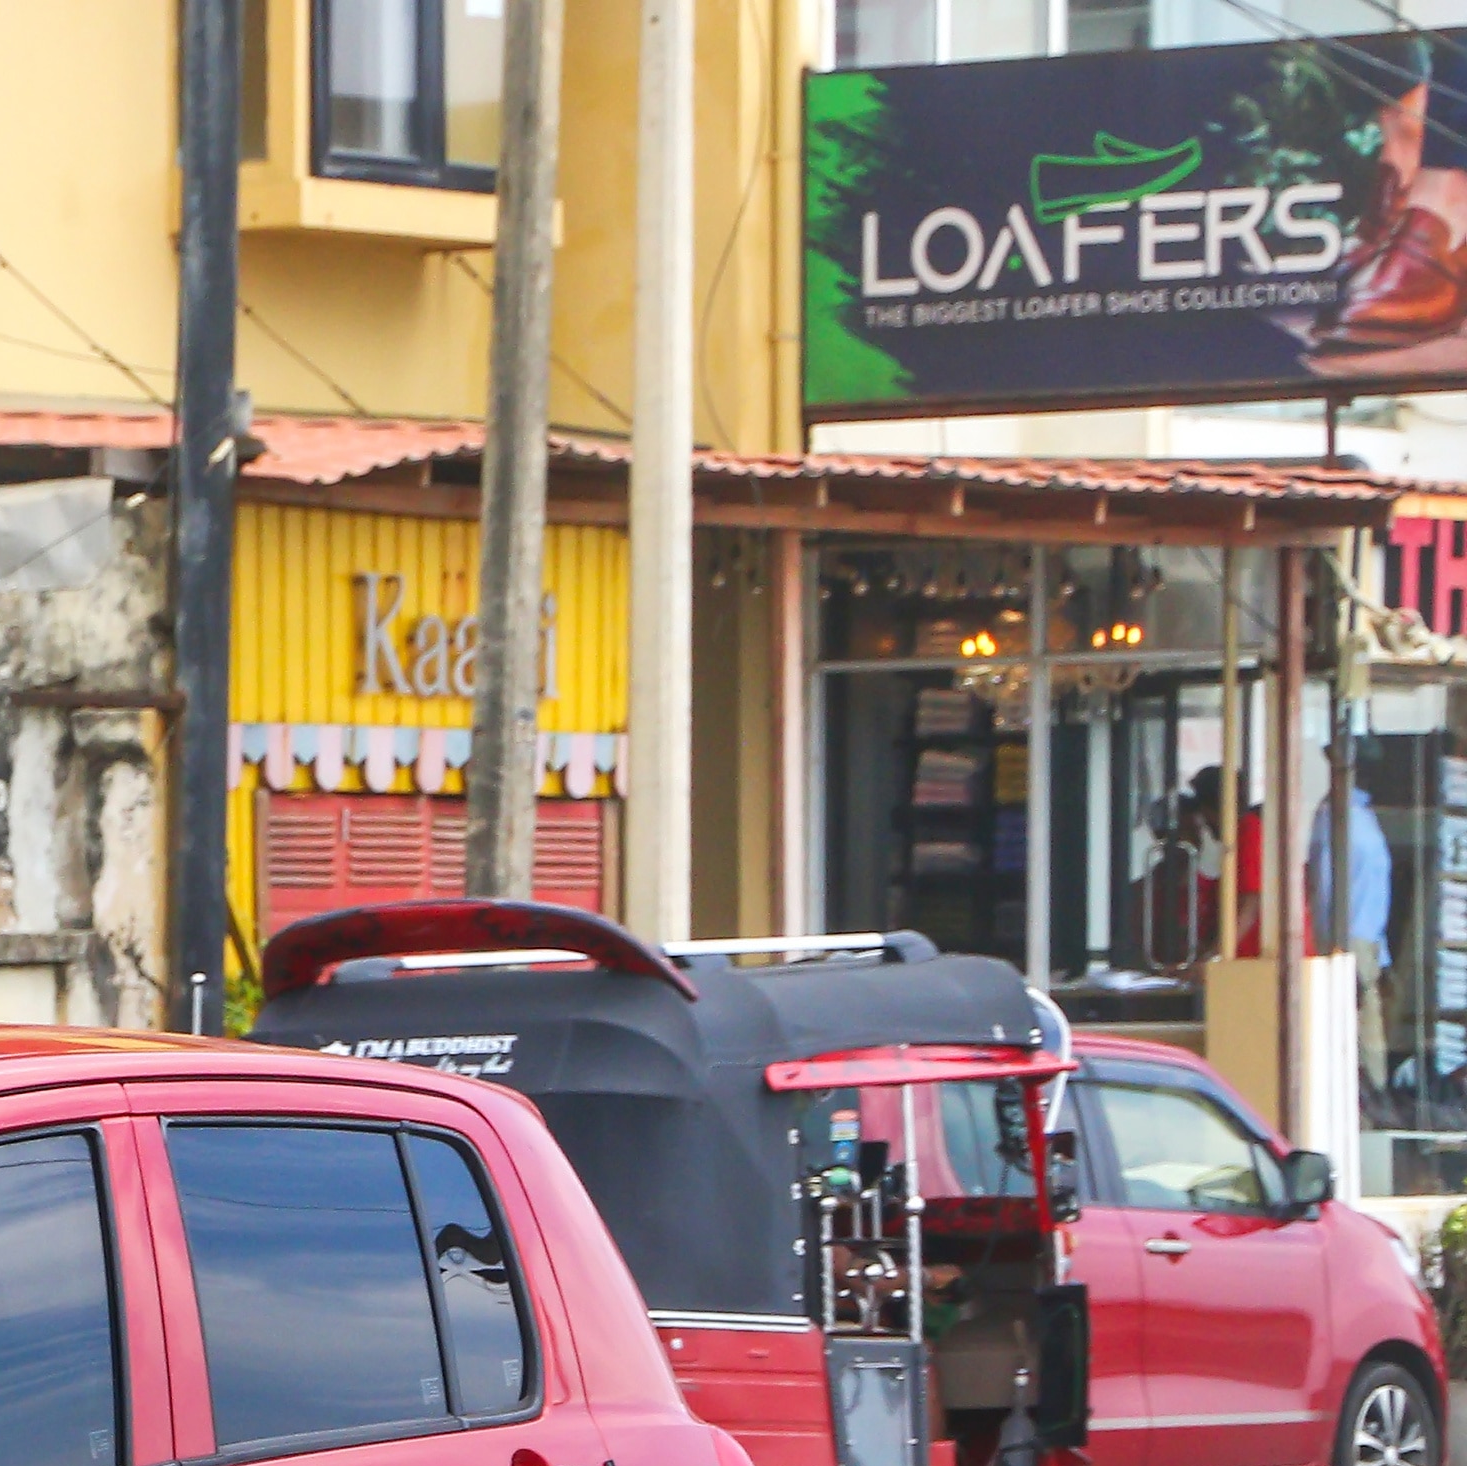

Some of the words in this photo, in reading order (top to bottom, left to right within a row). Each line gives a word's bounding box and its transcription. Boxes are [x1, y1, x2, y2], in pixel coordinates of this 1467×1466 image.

[862, 183, 1344, 298] LOAFERS
[866, 303, 907, 328] THE
[914, 299, 1008, 327] BIGGEST
[1014, 292, 1101, 320] LOAFER
[1105, 288, 1169, 316] SHOE
